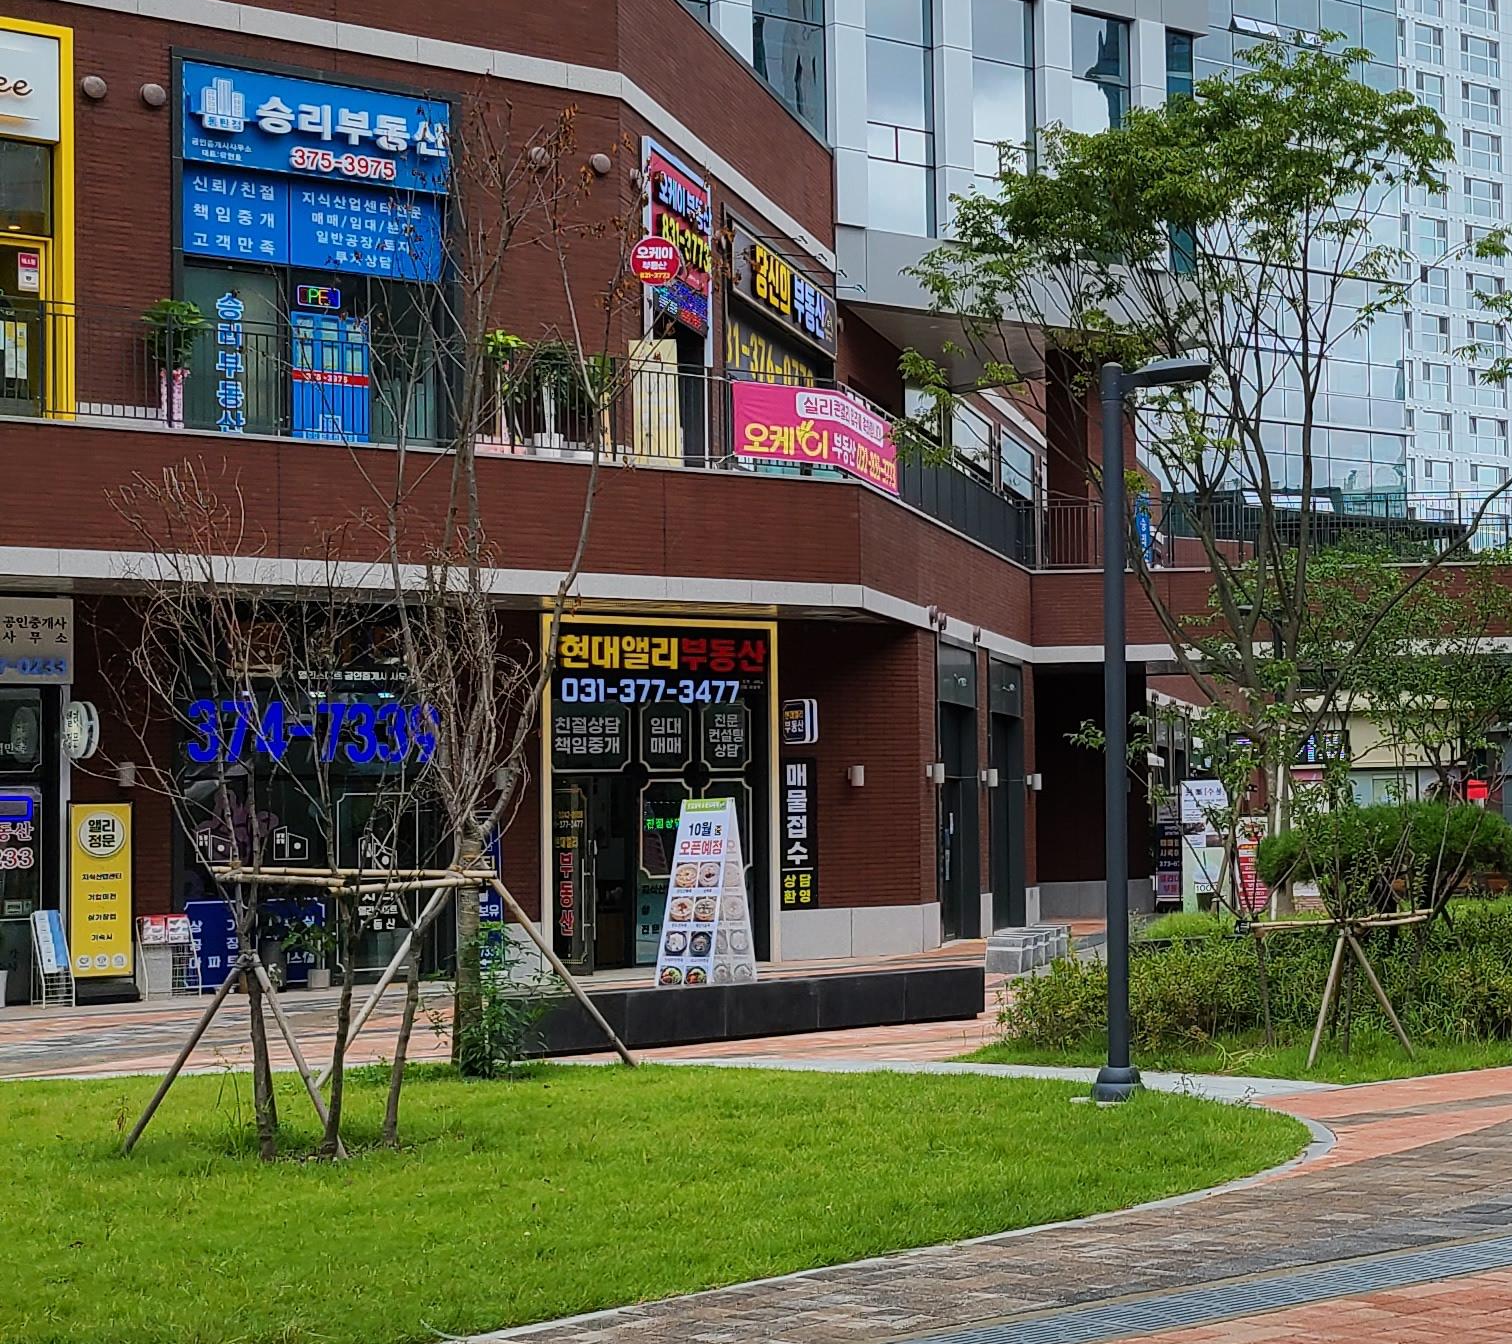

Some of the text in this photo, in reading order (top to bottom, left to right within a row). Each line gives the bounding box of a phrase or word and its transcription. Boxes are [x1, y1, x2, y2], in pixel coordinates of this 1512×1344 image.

[255, 95, 448, 158] 승리부동산
[291, 147, 396, 180] 375-3975
[192, 175, 275, 201] 신뢰/친절
[192, 203, 275, 229] 책임중개
[192, 232, 277, 256] 고객만족
[635, 246, 674, 260] 오케이
[2, 615, 67, 630] 공인중개사
[561, 677, 740, 705] 031-377-3477
[554, 716, 621, 735] 친절상담
[650, 717, 682, 735] 임대
[714, 713, 739, 728] 전문
[783, 720, 805, 733] 부동산
[187, 698, 441, 764] 374-7339
[708, 728, 744, 744] 컨설팅
[554, 736, 621, 755] 책임중개
[650, 737, 682, 754] 매매
[714, 744, 740, 758] 상담
[786, 763, 809, 865] 매물접수
[88, 819, 116, 833] 앨리
[688, 821, 713, 837] 10월
[88, 834, 116, 848] 정문
[679, 840, 723, 856] 오픈예정
[784, 874, 811, 888] 상담
[559, 852, 575, 937] 부동산
